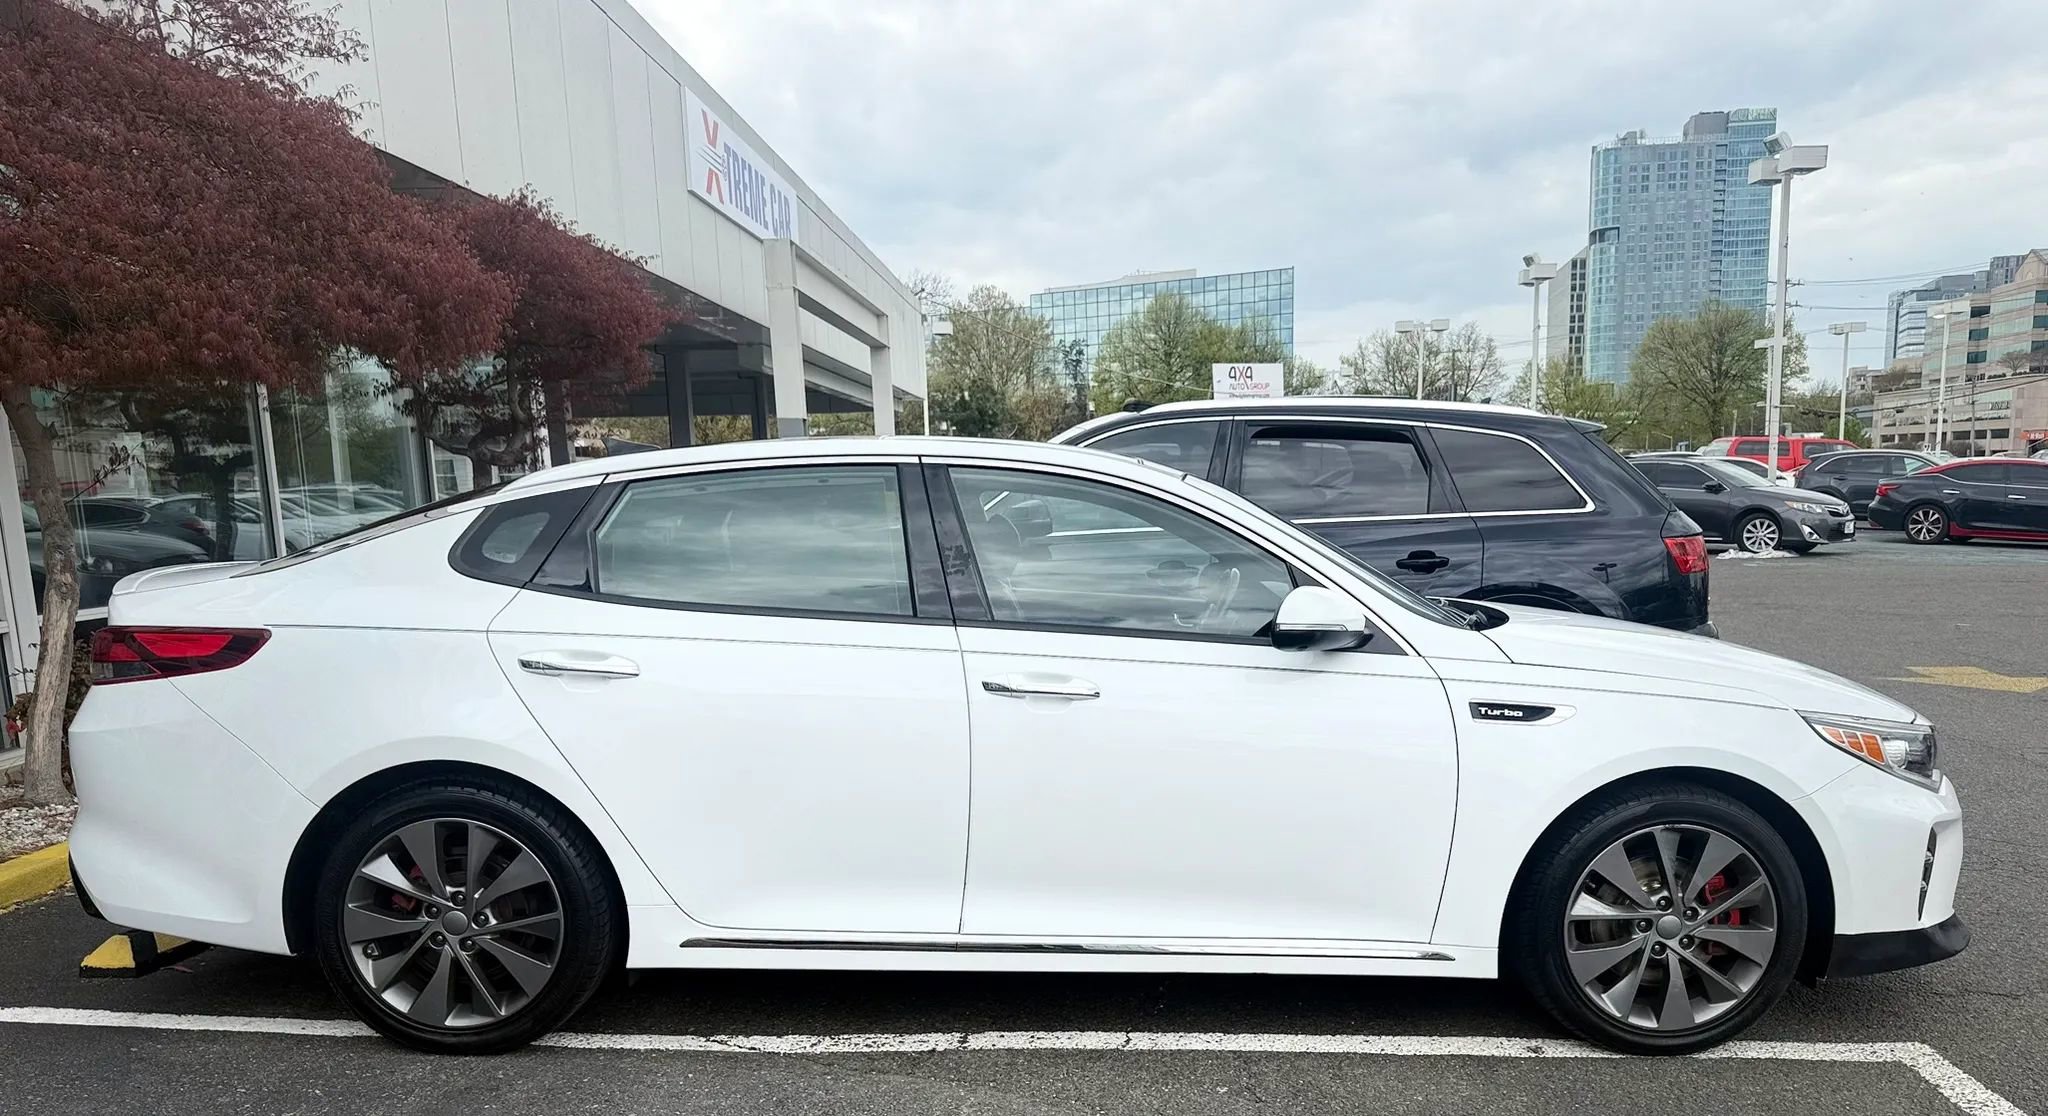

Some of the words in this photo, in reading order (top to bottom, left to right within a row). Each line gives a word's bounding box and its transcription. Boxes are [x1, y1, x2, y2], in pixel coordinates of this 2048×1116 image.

[769, 183, 792, 241] CAR
[1229, 382, 1245, 390] AUTO
[1249, 382, 1270, 391] GROUP
[1478, 707, 1523, 717] Turbo
